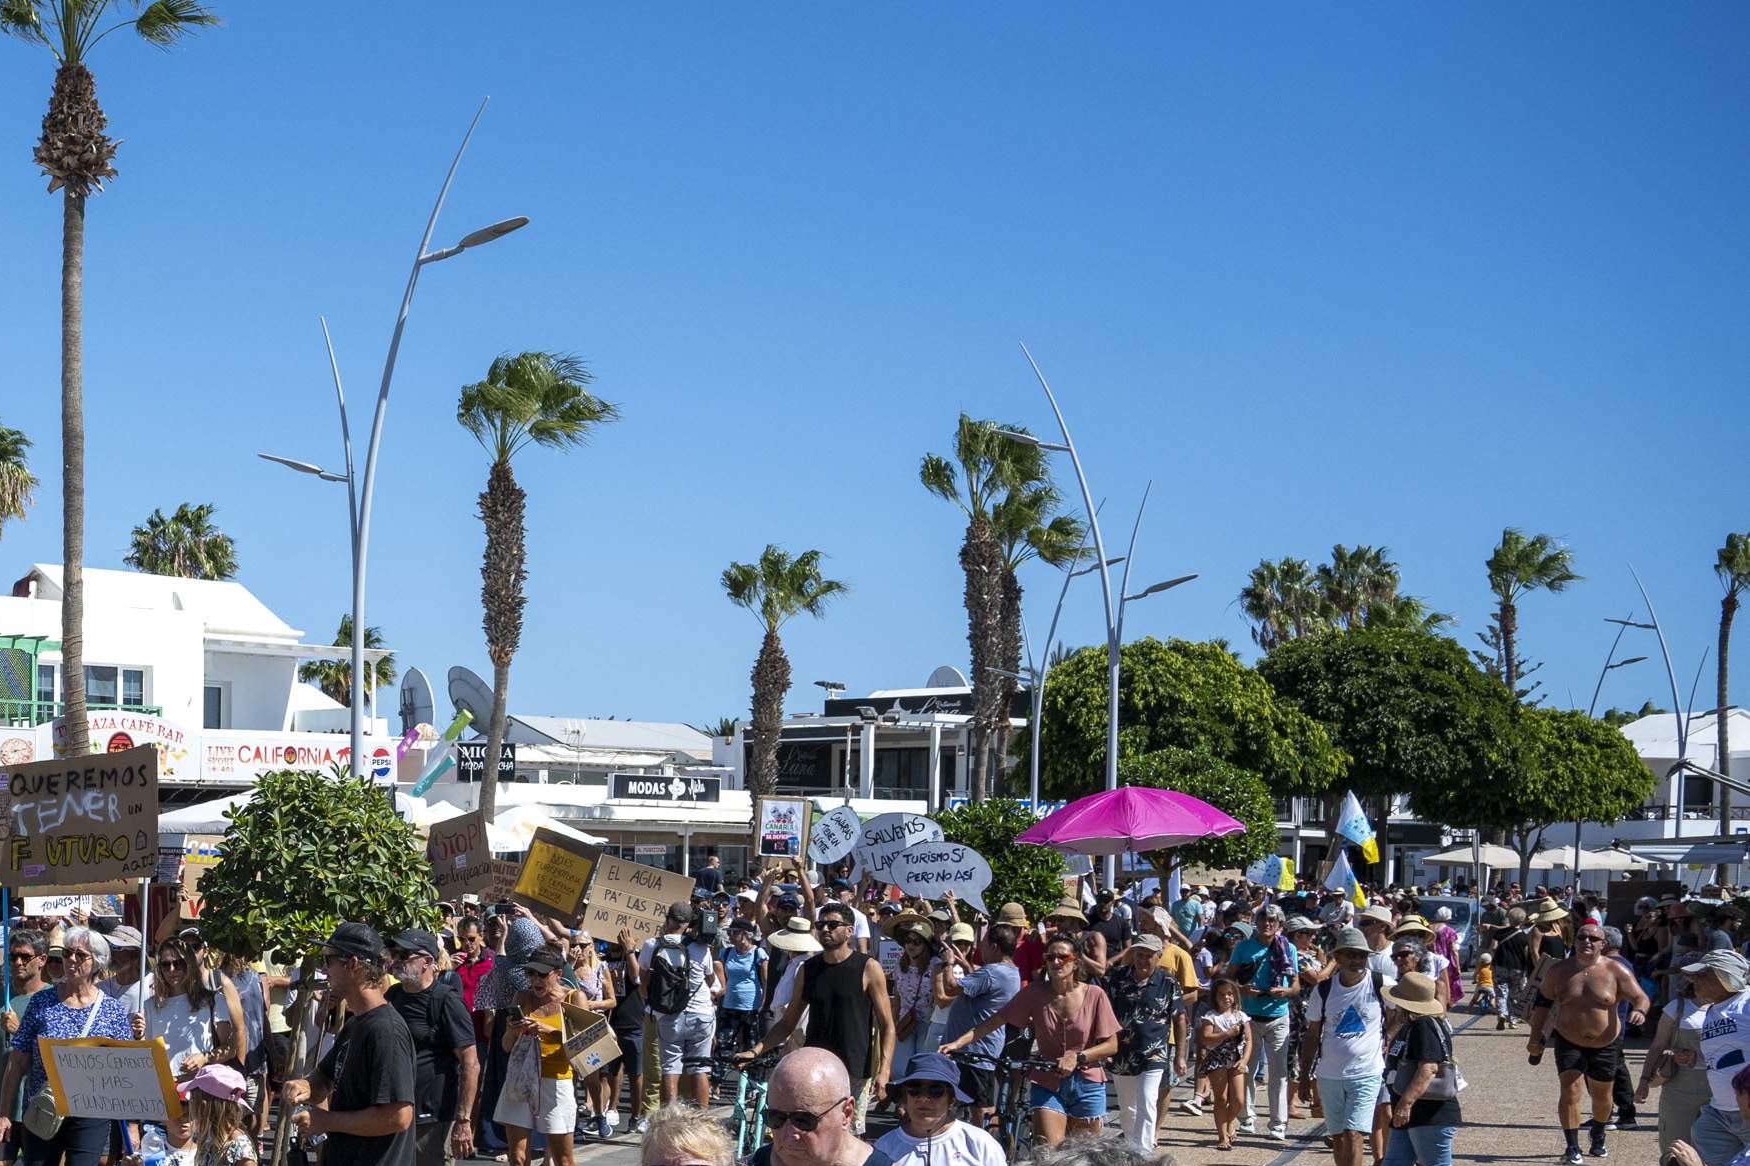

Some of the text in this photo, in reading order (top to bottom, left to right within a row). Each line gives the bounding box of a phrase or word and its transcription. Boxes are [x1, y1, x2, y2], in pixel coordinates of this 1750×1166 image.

[157, 725, 184, 744] BAR
[208, 746, 234, 755] LIVE
[238, 745, 333, 766] CALIFORNIA
[207, 757, 234, 765] SPORT
[461, 761, 484, 771] MODA
[9, 764, 147, 797] QUEREMOS
[628, 781, 666, 795] MODAS
[11, 789, 122, 837] TENER
[128, 803, 143, 816] UN
[864, 817, 926, 847] SALVEMOS
[10, 832, 130, 872] FUTURO
[903, 847, 967, 865] TURISMO SÍ
[608, 866, 662, 892] EL AGUA
[906, 867, 976, 883] PERO NO ASÍ
[626, 896, 647, 912] LAS
[594, 911, 609, 921] NO
[633, 919, 651, 933] LAS
[58, 1053, 154, 1070] MENOS CEMENTO
[85, 1076, 98, 1093] Y
[71, 1093, 166, 1115] FUNDAMENTO
